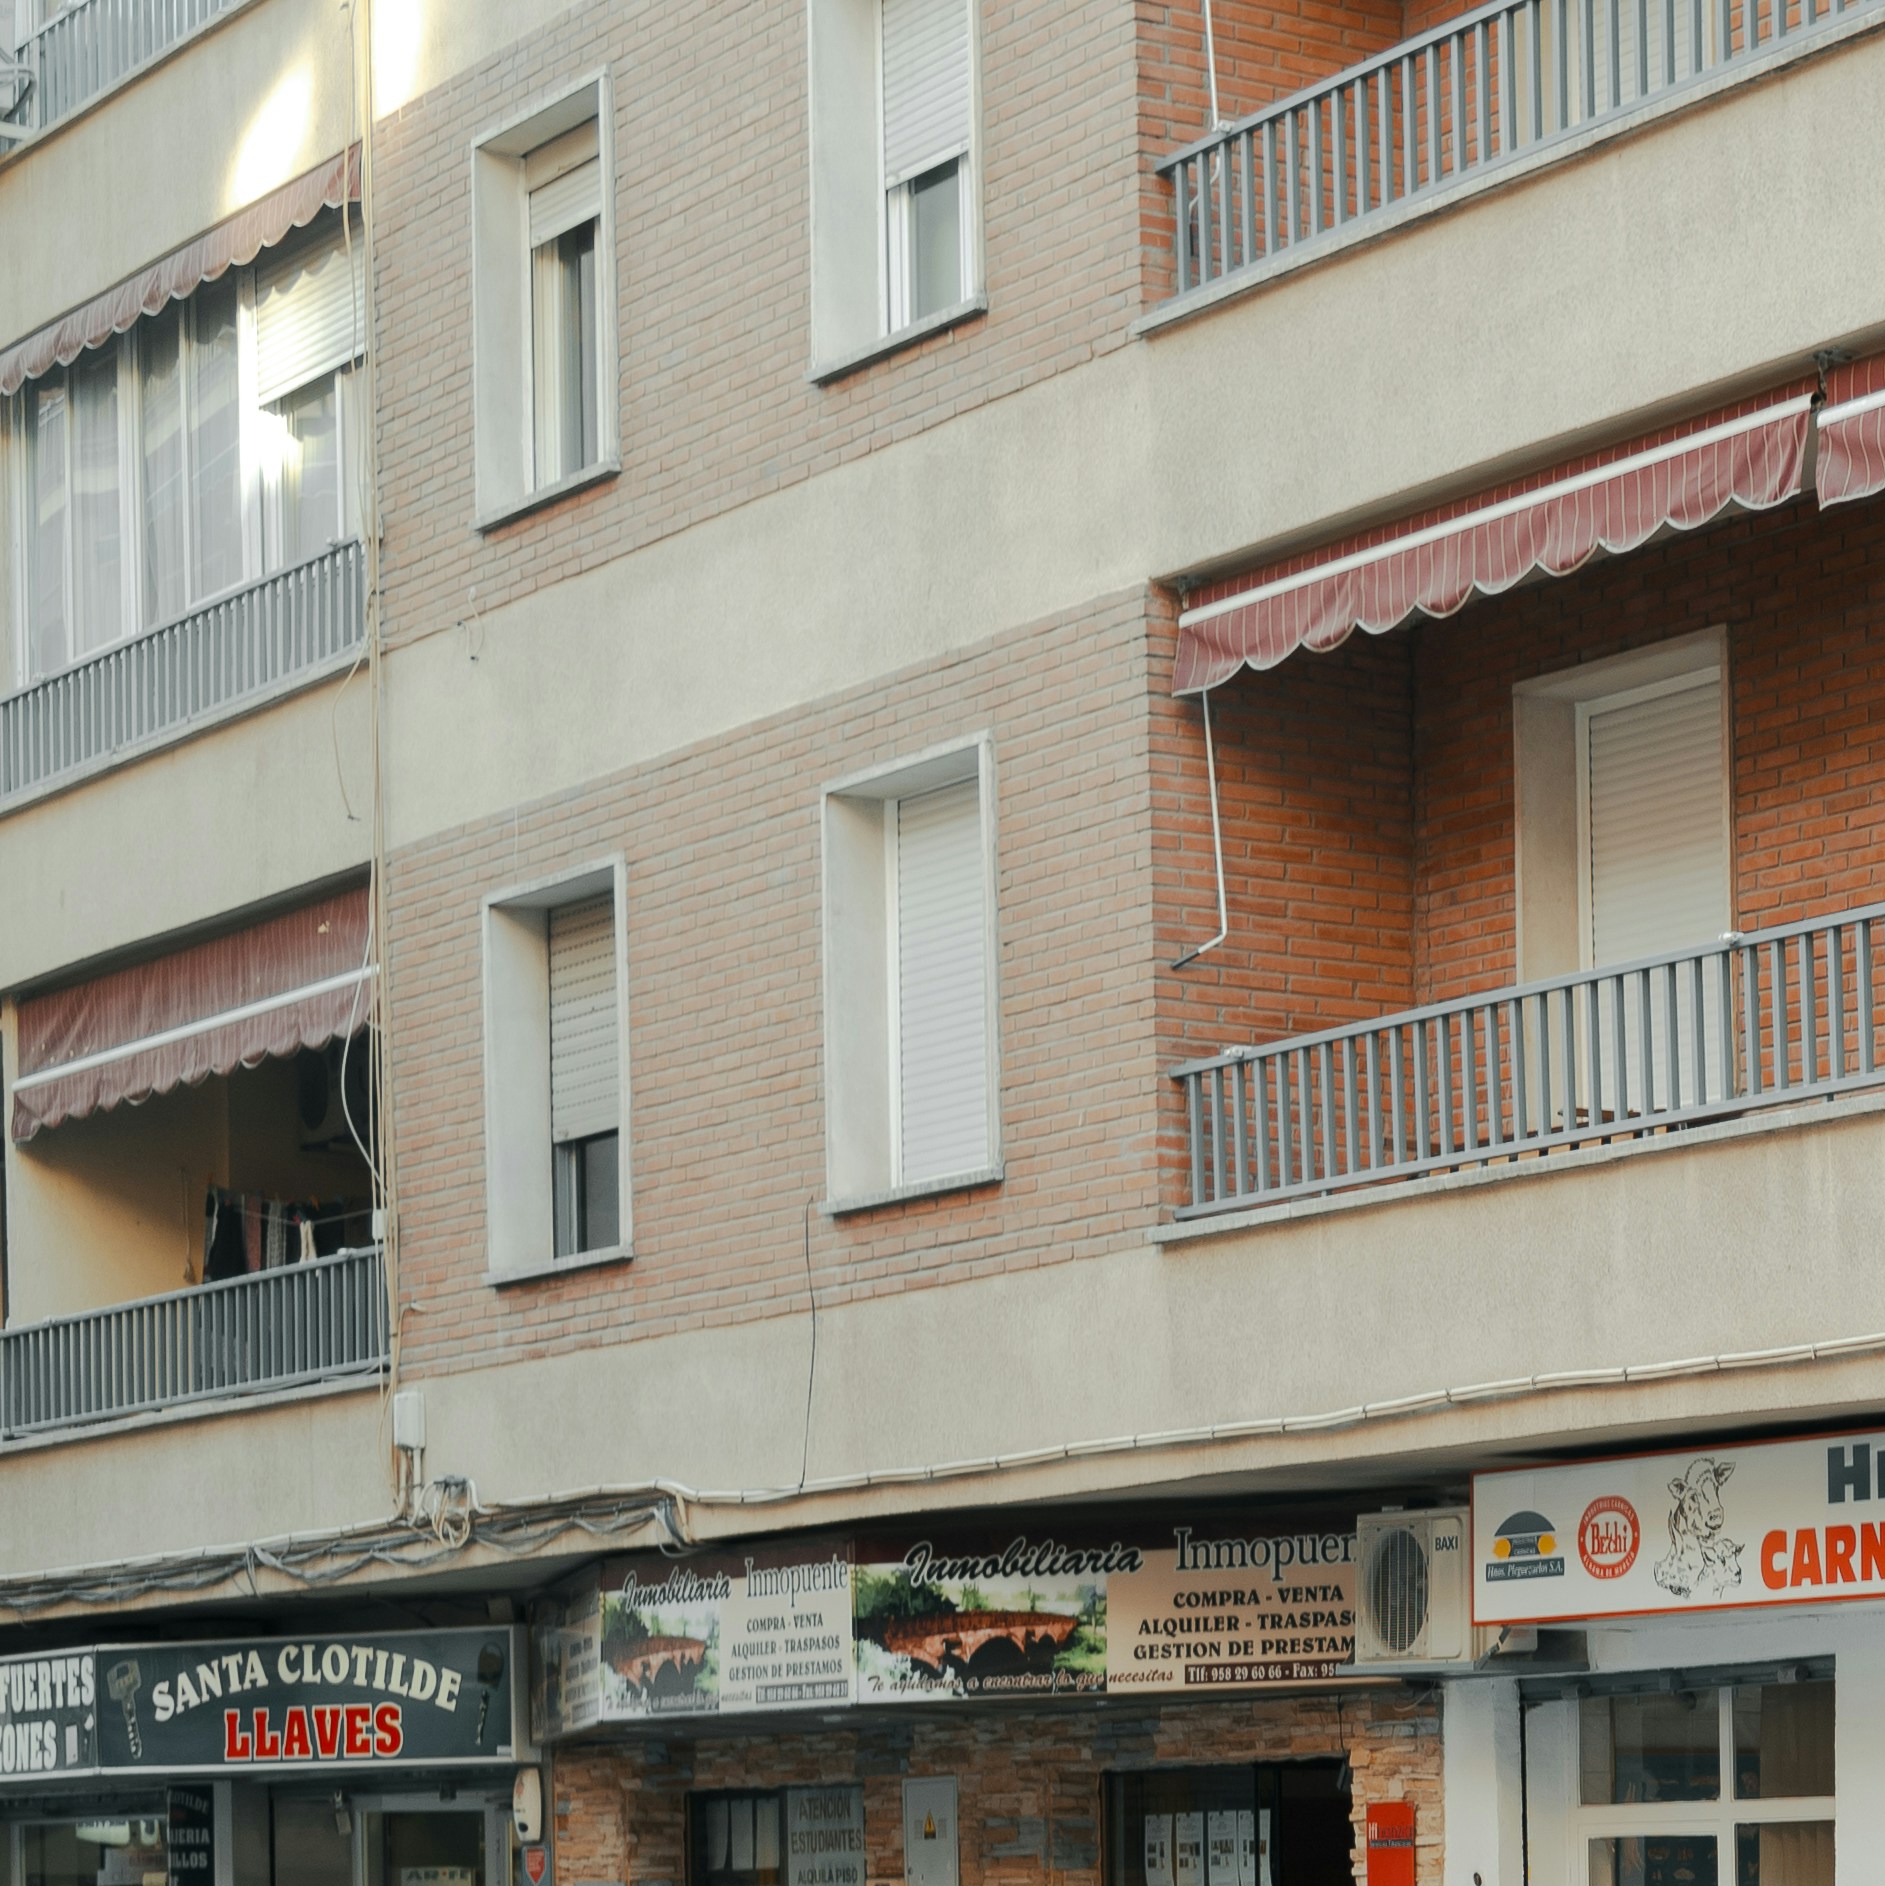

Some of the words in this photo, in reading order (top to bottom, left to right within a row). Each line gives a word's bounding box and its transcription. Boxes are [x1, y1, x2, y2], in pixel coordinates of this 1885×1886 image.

[1434, 1535, 1459, 1551] BAXI
[904, 1536, 1143, 1588] Inmobiliaria
[623, 1566, 732, 1613] Inmobiliaria
[745, 1554, 849, 1608] Inmopuente
[1173, 1587, 1260, 1609] COMPRA
[1278, 1584, 1344, 1604] VENTA
[746, 1615, 786, 1633] COMPRA
[793, 1612, 824, 1629] VENTA
[1138, 1617, 1240, 1637] ALQUILER
[1257, 1610, 1356, 1630] TRASPAS
[731, 1641, 777, 1660] ALQUILER
[784, 1634, 841, 1654] TRASPASOS
[1133, 1640, 1222, 1661] GESTION
[1228, 1640, 1254, 1657] DE
[1261, 1634, 1356, 1655] PRESTAM
[152, 1650, 269, 1722] SANTA
[277, 1644, 462, 1713] CLOTILDE
[729, 1663, 768, 1682] GESTION
[771, 1663, 783, 1679] DE
[786, 1659, 843, 1677] PRESTAMOS
[1108, 1669, 1174, 1685] necesitas
[1211, 1664, 1231, 1681] 958
[1235, 1664, 1248, 1680] 29
[1251, 1663, 1265, 1680] 60
[1268, 1663, 1282, 1680] 66
[1293, 1662, 1319, 1679] Fax:
[223, 1701, 404, 1762] LLAVES
[0, 1719, 57, 1773] ONES
[791, 1828, 863, 1855] ESTUDIANTES
[835, 1867, 858, 1883] PISO
